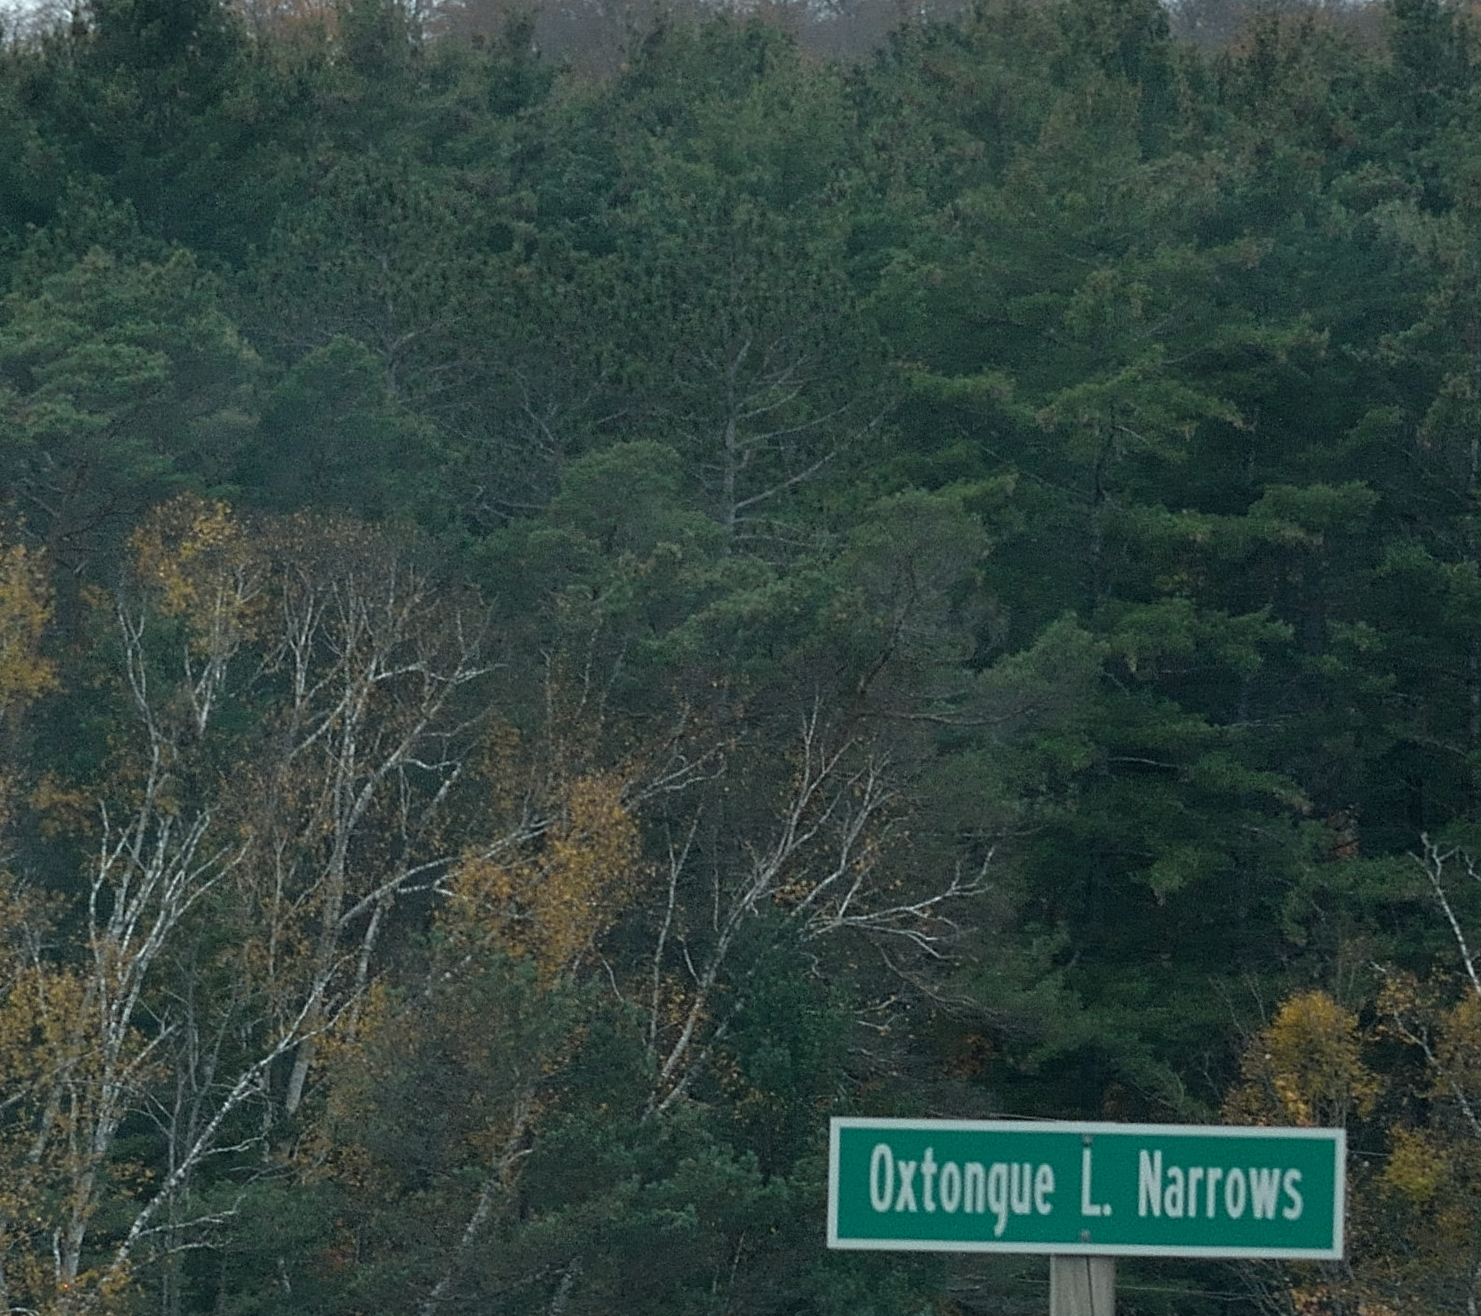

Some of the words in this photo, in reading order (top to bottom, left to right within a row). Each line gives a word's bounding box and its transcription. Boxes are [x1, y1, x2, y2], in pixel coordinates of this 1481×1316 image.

[868, 1142, 1055, 1237] Oxtongue
[1081, 1146, 1113, 1217] L.
[1137, 1148, 1305, 1221] Narrows
